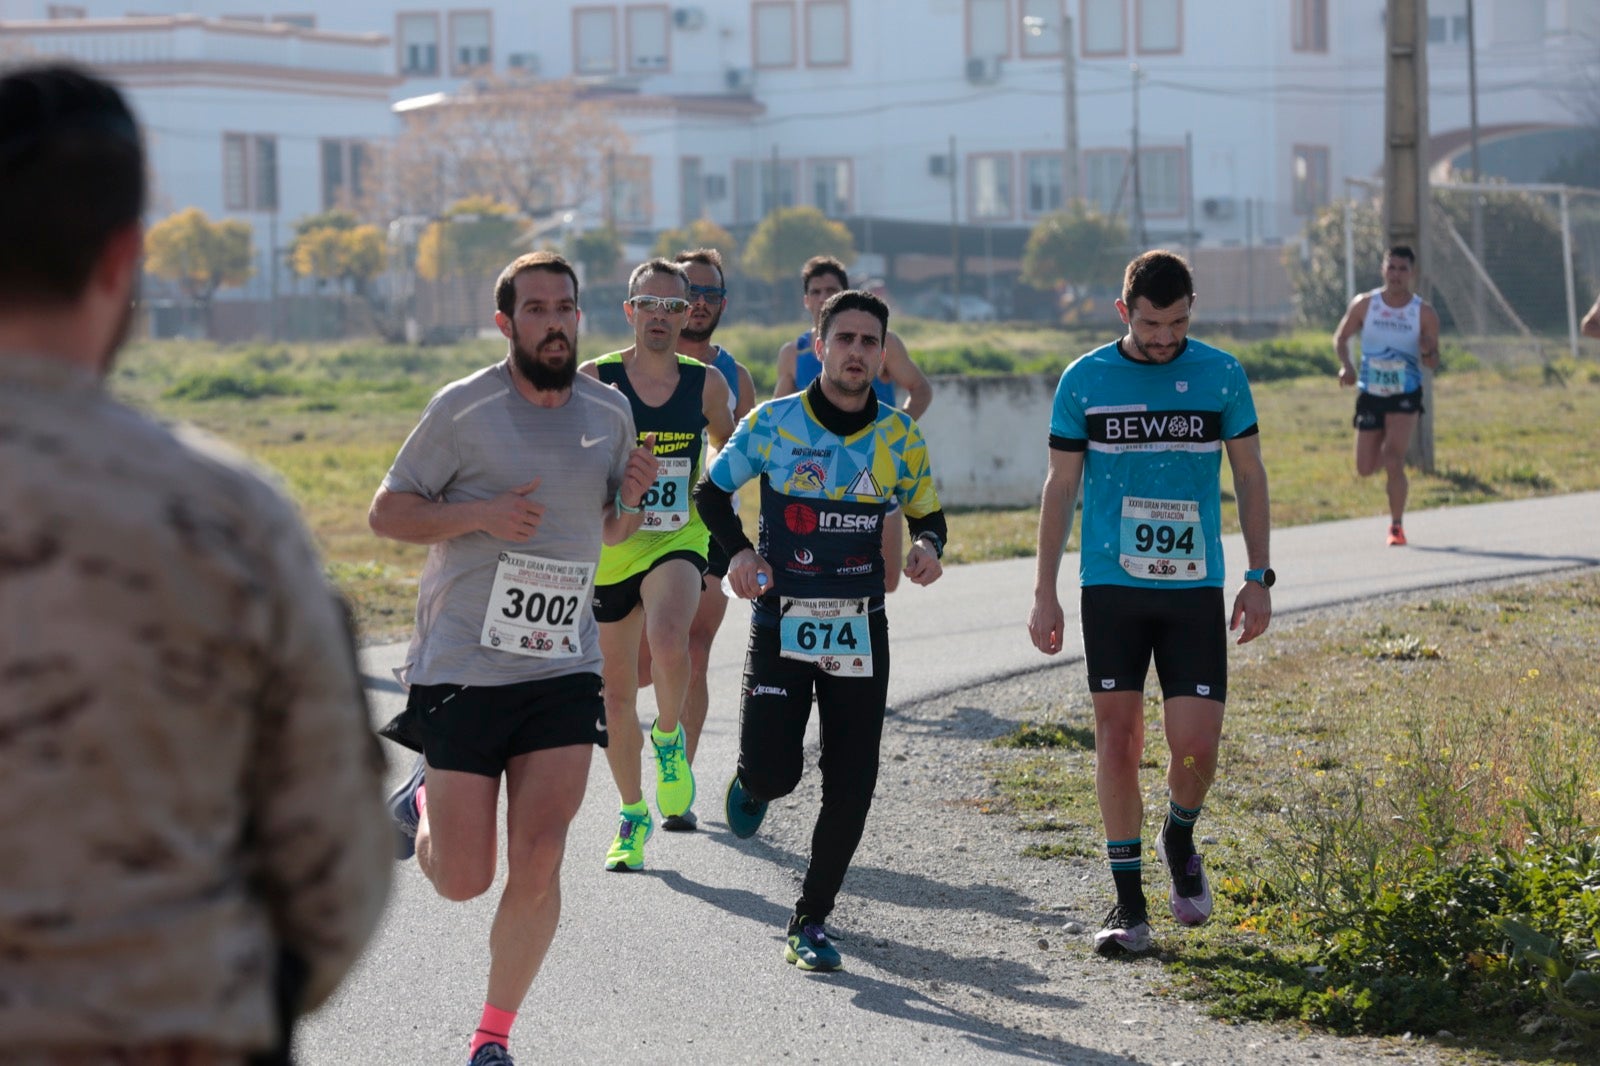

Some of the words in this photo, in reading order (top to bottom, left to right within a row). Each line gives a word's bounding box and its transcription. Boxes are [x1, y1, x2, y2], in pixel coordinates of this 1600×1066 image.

[1144, 501, 1159, 510] GRAN
[1160, 502, 1181, 512] PREMIO
[1136, 524, 1194, 554] 994
[502, 588, 578, 625] 3002
[797, 621, 857, 650] 674
